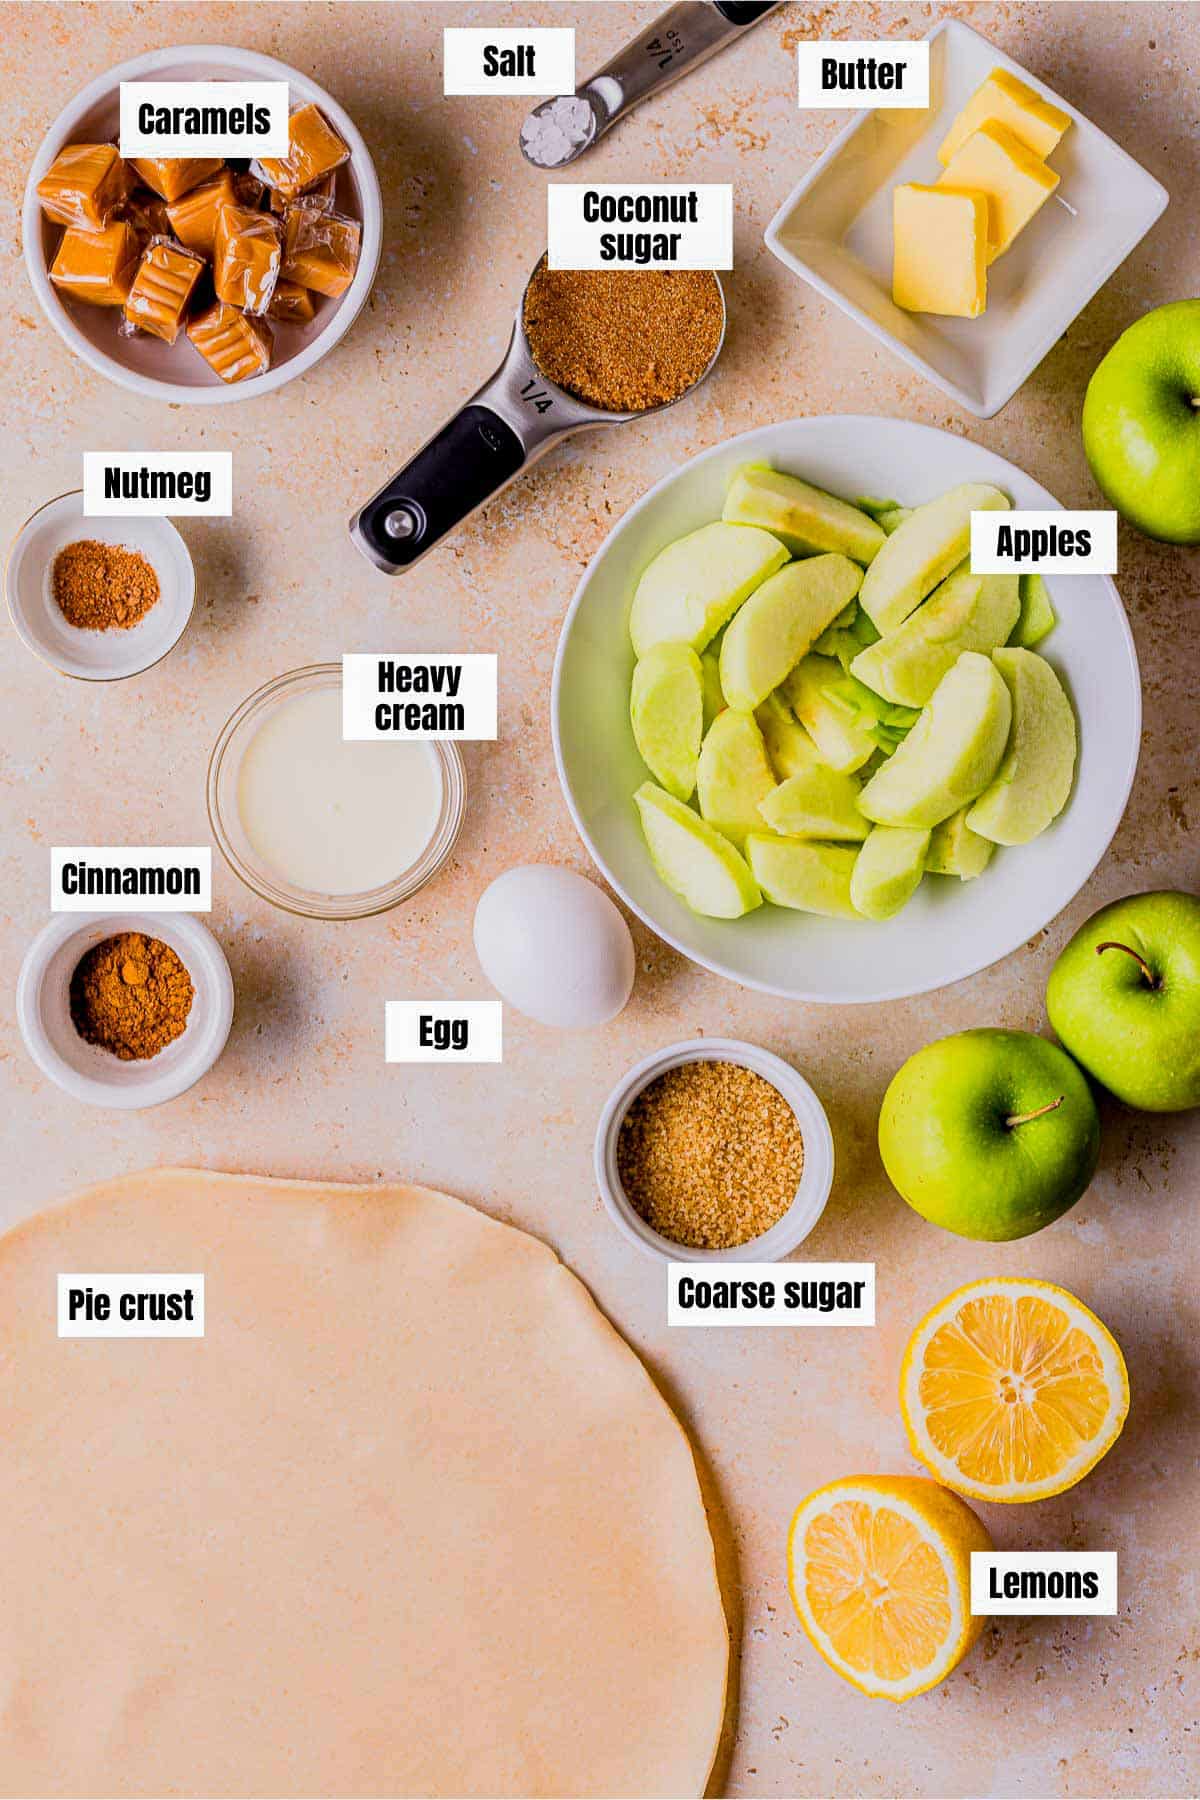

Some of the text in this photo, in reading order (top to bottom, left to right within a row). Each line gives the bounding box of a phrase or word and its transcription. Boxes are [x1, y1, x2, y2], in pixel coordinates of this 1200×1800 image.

[646, 38, 673, 69] 1/4
[666, 30, 684, 53] tsp
[520, 379, 553, 414] 1/4
